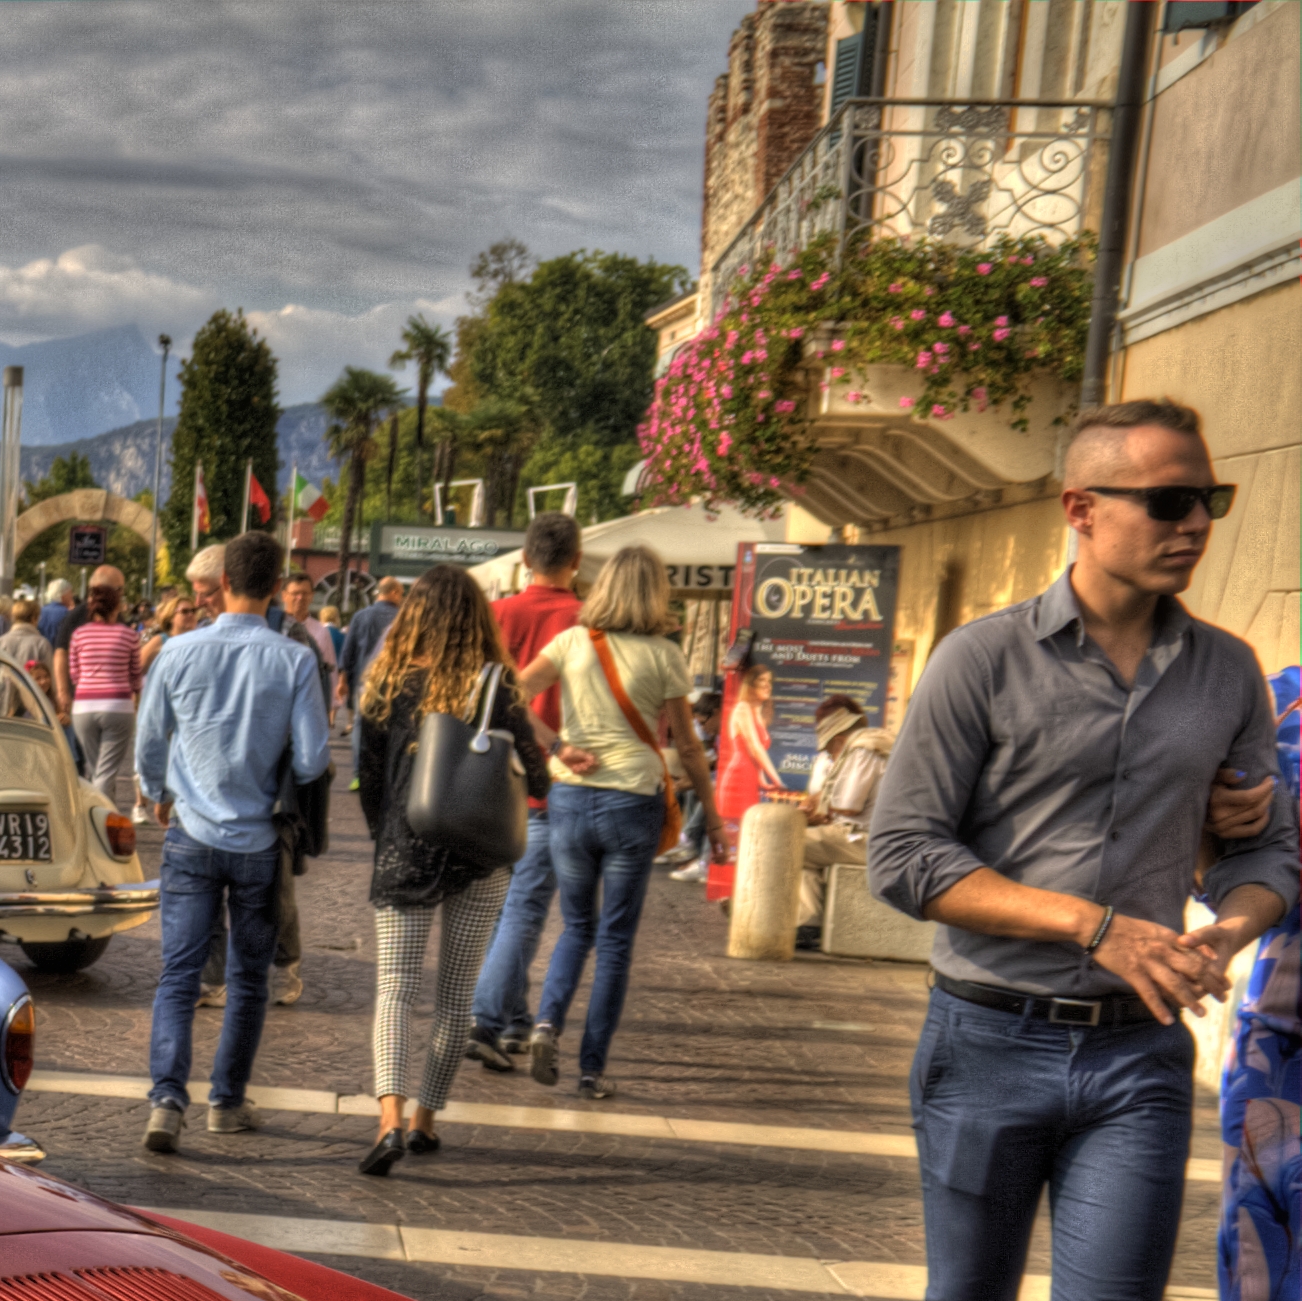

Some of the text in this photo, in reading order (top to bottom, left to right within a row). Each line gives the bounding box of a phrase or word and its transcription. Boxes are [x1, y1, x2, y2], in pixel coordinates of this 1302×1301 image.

[394, 534, 500, 556] MIRALAGO
[789, 567, 882, 588] ITALIAN
[756, 576, 884, 621] OPERA
